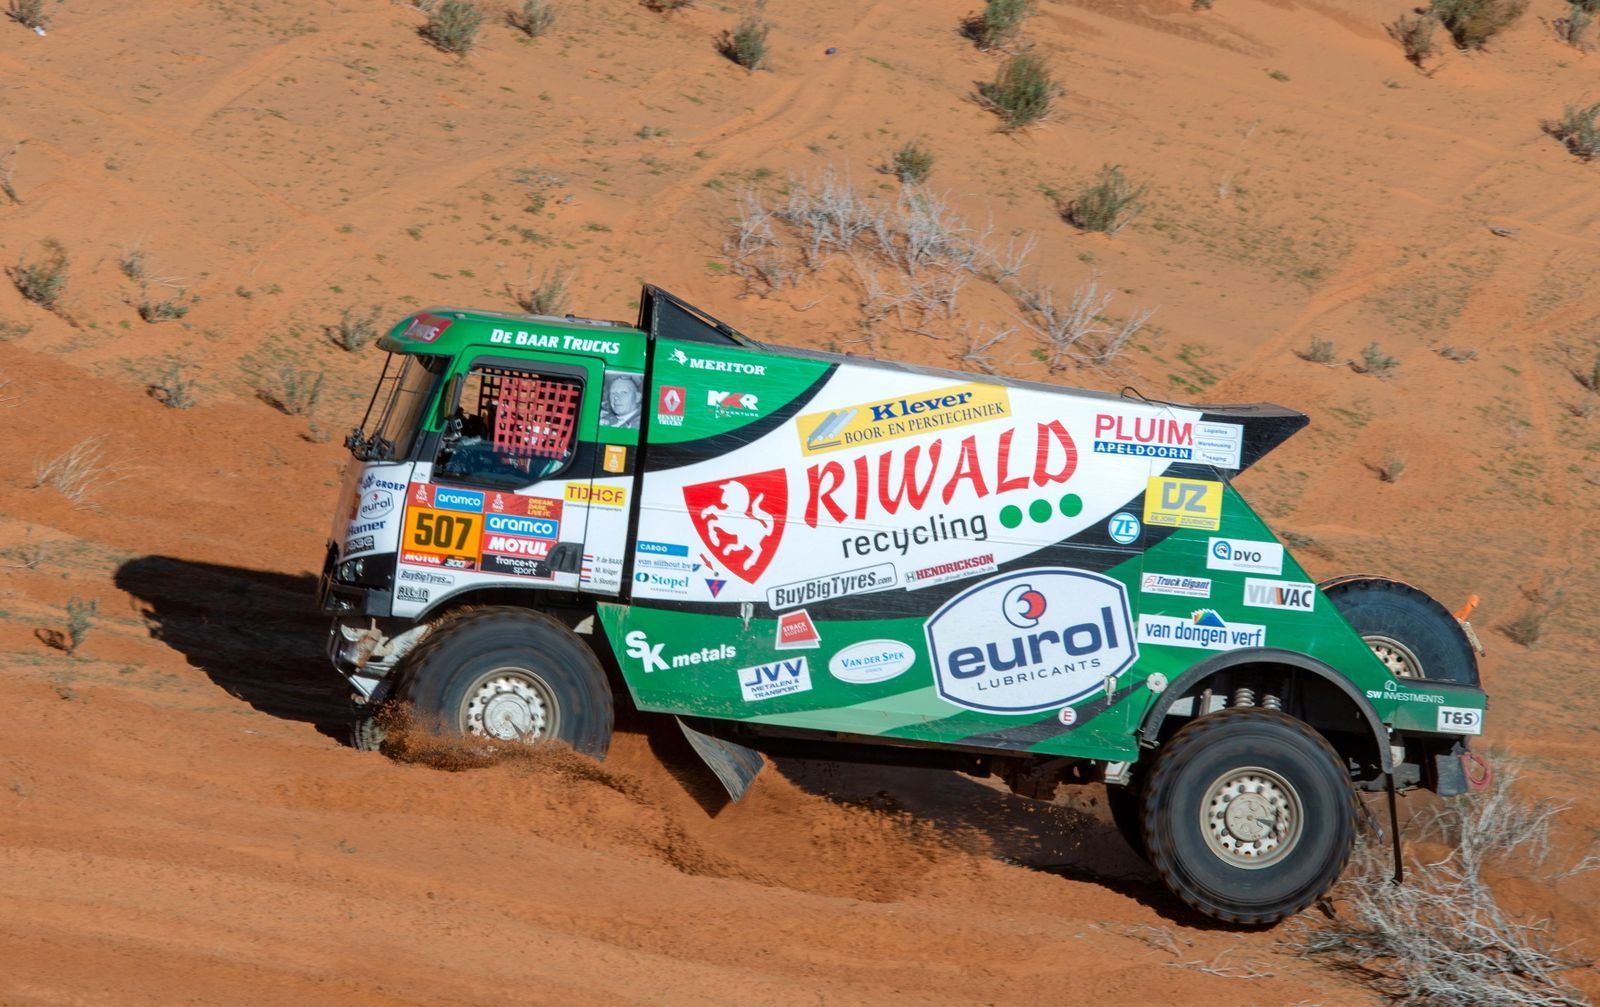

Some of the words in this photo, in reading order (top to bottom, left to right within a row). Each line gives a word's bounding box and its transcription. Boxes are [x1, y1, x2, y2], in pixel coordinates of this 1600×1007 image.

[490, 328, 513, 343] DE
[515, 331, 559, 348] BAAR
[563, 335, 620, 354] TRUCKS
[689, 358, 766, 376] MERITOR
[869, 391, 973, 422] Klever
[844, 426, 886, 444] BOOR-
[888, 421, 906, 435] EN
[908, 401, 1005, 433] PERSTECHNIEK
[1095, 414, 1193, 446] PLUIM
[1096, 442, 1189, 459] APELDOORN
[803, 419, 1078, 528] RIWALD
[375, 480, 406, 491] GROEP
[567, 486, 623, 503] TIJHOF
[362, 497, 391, 513] eurol
[438, 493, 481, 506] aramco
[414, 512, 473, 550] 507
[489, 517, 553, 534] aramco
[1112, 518, 1138, 538] ZF
[842, 513, 988, 558] recycling
[488, 536, 549, 556] MOTUL
[640, 543, 668, 552] CARGO
[404, 554, 441, 564] MOTUL
[1233, 550, 1262, 562] DVO
[513, 567, 537, 576] sport
[915, 553, 994, 580] HENDRICKSON
[651, 573, 689, 589] Stopel
[775, 571, 893, 606] BuyBigTyres.com
[1156, 576, 1181, 586] Truck
[1181, 578, 1210, 590] Gigant
[1247, 584, 1313, 608] VIAVAC
[948, 606, 1119, 680] eurol
[1145, 623, 1171, 638] van
[1175, 621, 1228, 647] dongen
[1231, 628, 1262, 648] verf
[625, 630, 671, 673] SK
[672, 644, 736, 668] metals
[841, 658, 862, 668] VAN
[864, 655, 881, 665] DER
[882, 652, 904, 661] SPEK
[745, 659, 803, 687] JVV
[977, 658, 1101, 691] LUBRICANTS
[751, 679, 793, 693] METALEN
[753, 685, 799, 699] TRANSPORT
[1366, 690, 1382, 699] SW
[1383, 692, 1445, 704] INVESTMENTS
[1063, 710, 1073, 722] E
[1442, 711, 1474, 725] T&S
